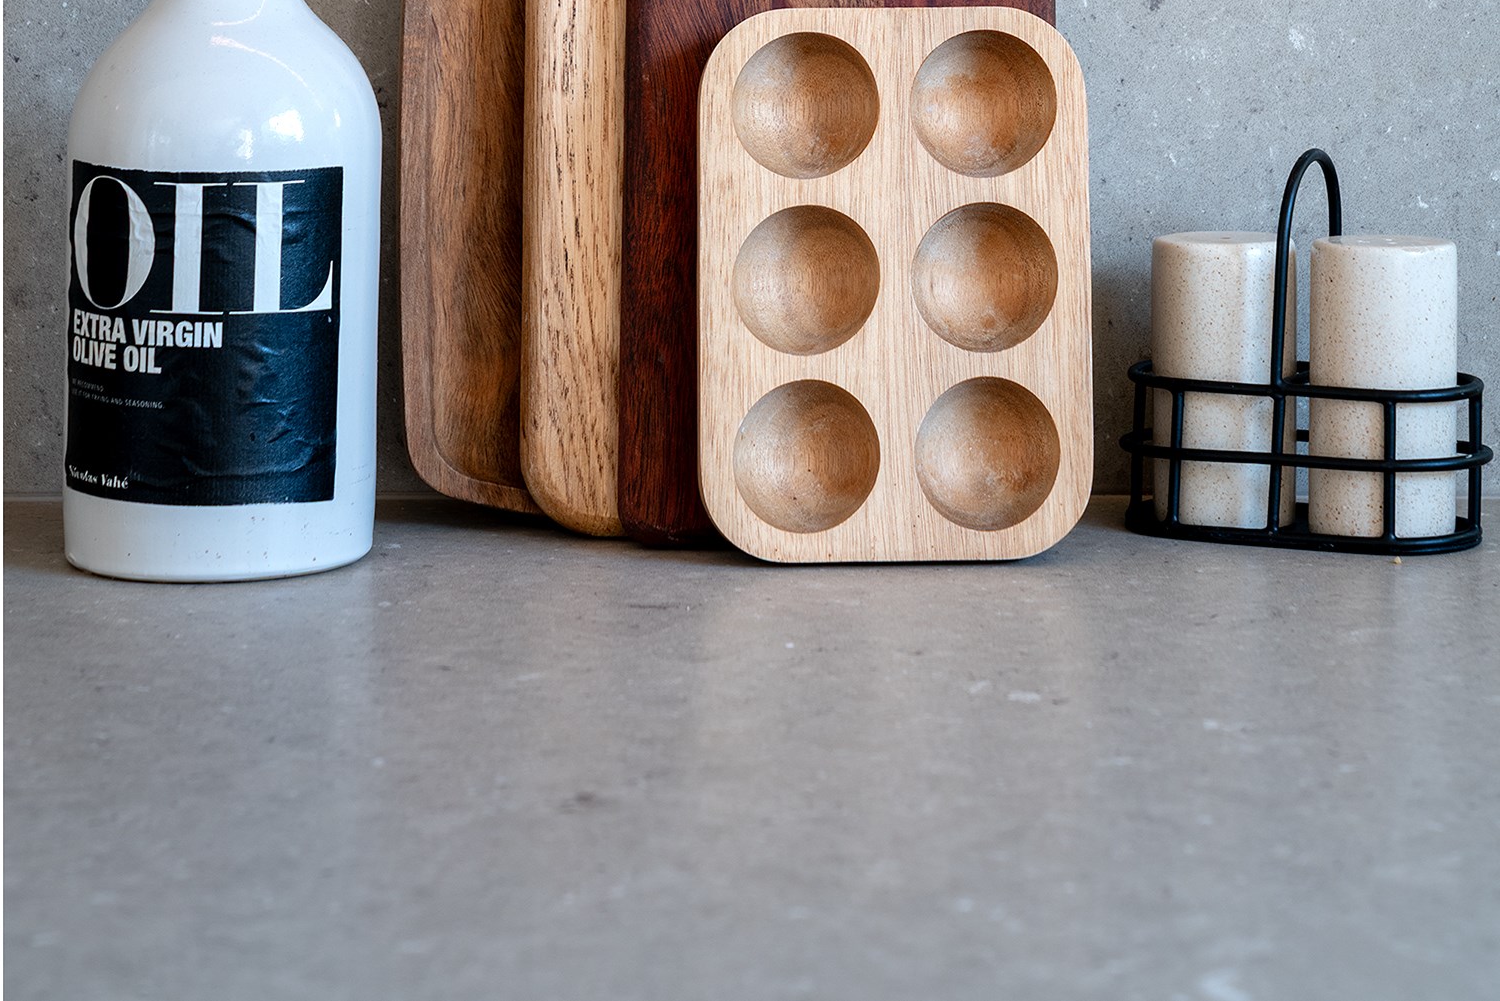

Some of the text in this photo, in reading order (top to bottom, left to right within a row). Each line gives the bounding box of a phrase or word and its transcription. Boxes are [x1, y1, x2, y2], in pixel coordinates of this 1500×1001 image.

[74, 175, 334, 316] OIL
[73, 308, 223, 349] EXTRA VIRGIN
[72, 335, 162, 374] OLIVE OIL
[111, 397, 123, 406] AND
[124, 398, 165, 410] SEASONING.
[101, 473, 129, 490] Vahé
